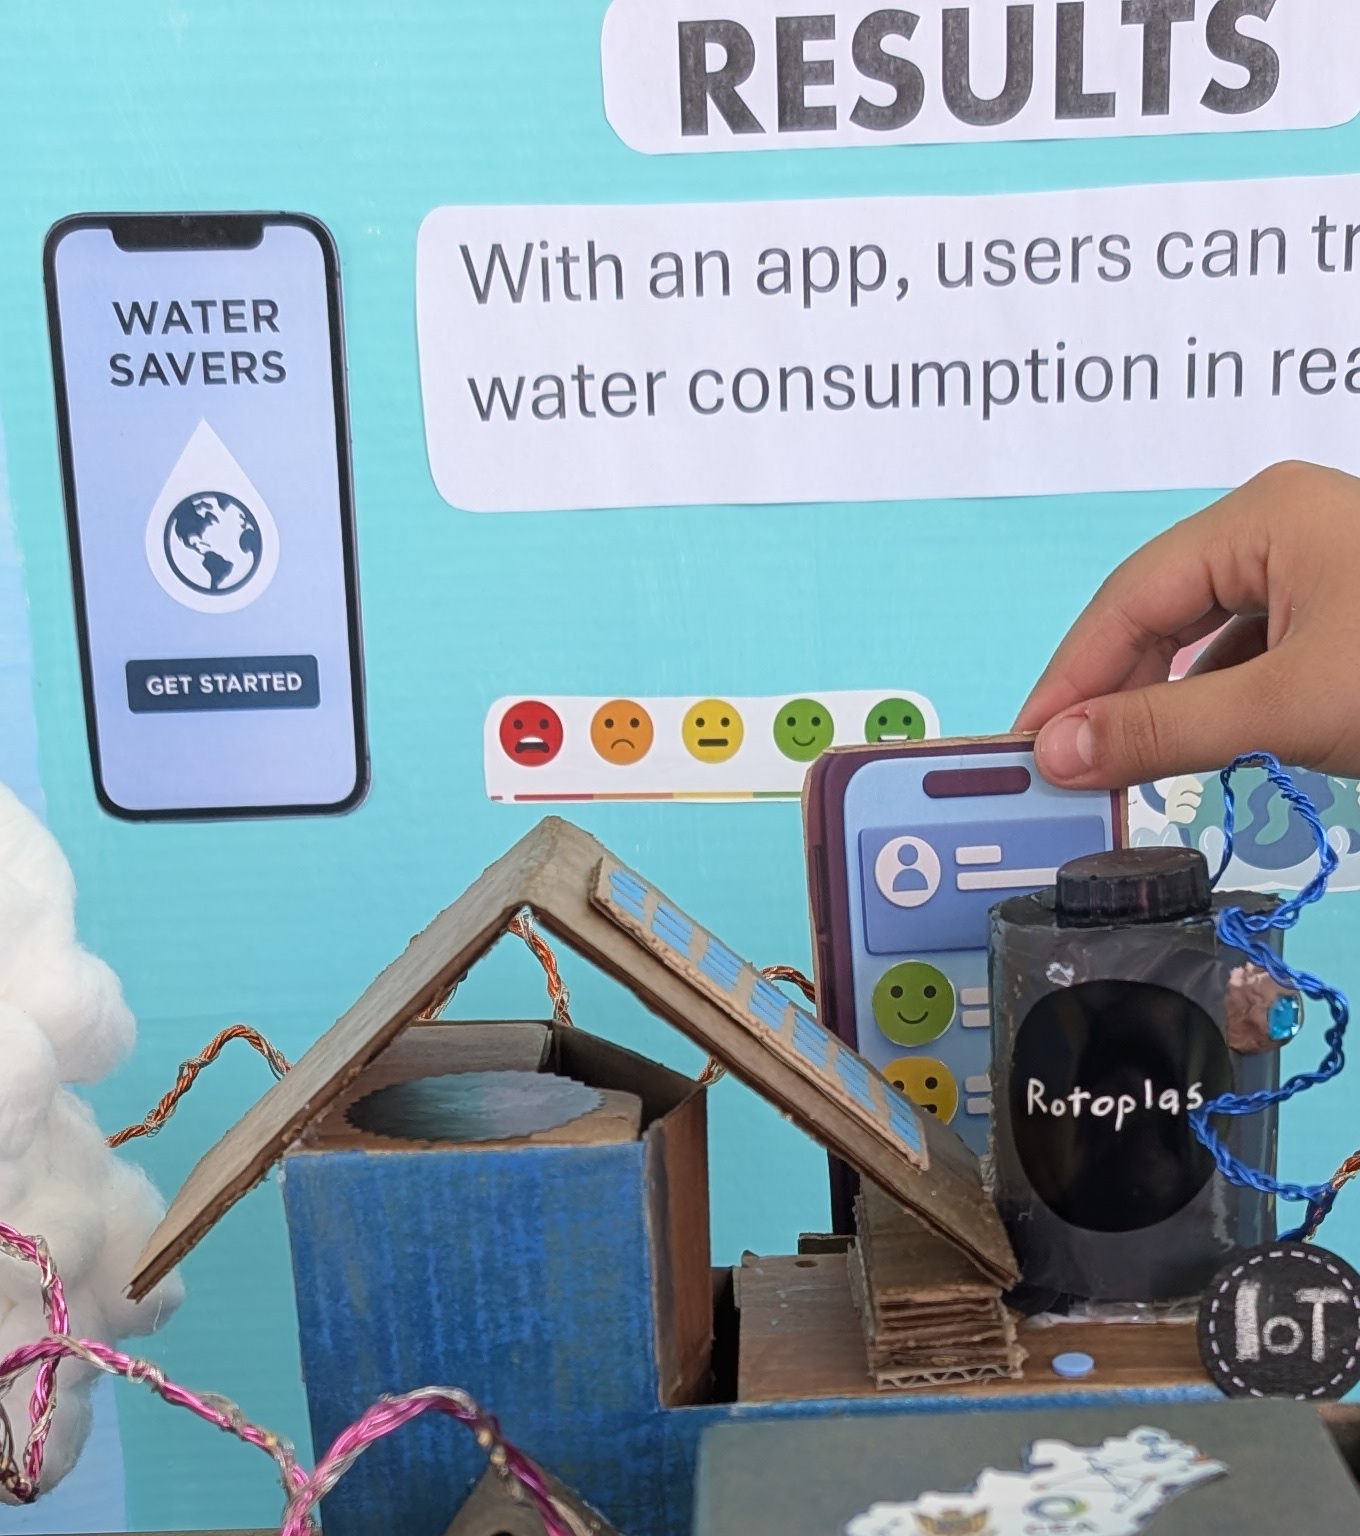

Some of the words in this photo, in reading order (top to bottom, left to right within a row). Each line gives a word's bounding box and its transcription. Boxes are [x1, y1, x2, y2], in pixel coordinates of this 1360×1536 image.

[677, 0, 1280, 137] RESULTS
[459, 238, 625, 306] With
[647, 246, 732, 302] an
[755, 239, 911, 310] app,
[936, 229, 1132, 290] users
[1156, 225, 1287, 280] can
[111, 298, 281, 337] WATER
[108, 350, 288, 388] SAVERS
[467, 364, 668, 423] water
[687, 339, 1160, 421] consumption
[1186, 336, 1243, 399] in
[145, 674, 192, 697] GET
[198, 671, 303, 696] STARTED
[1026, 1077, 1205, 1131] Rotoplas
